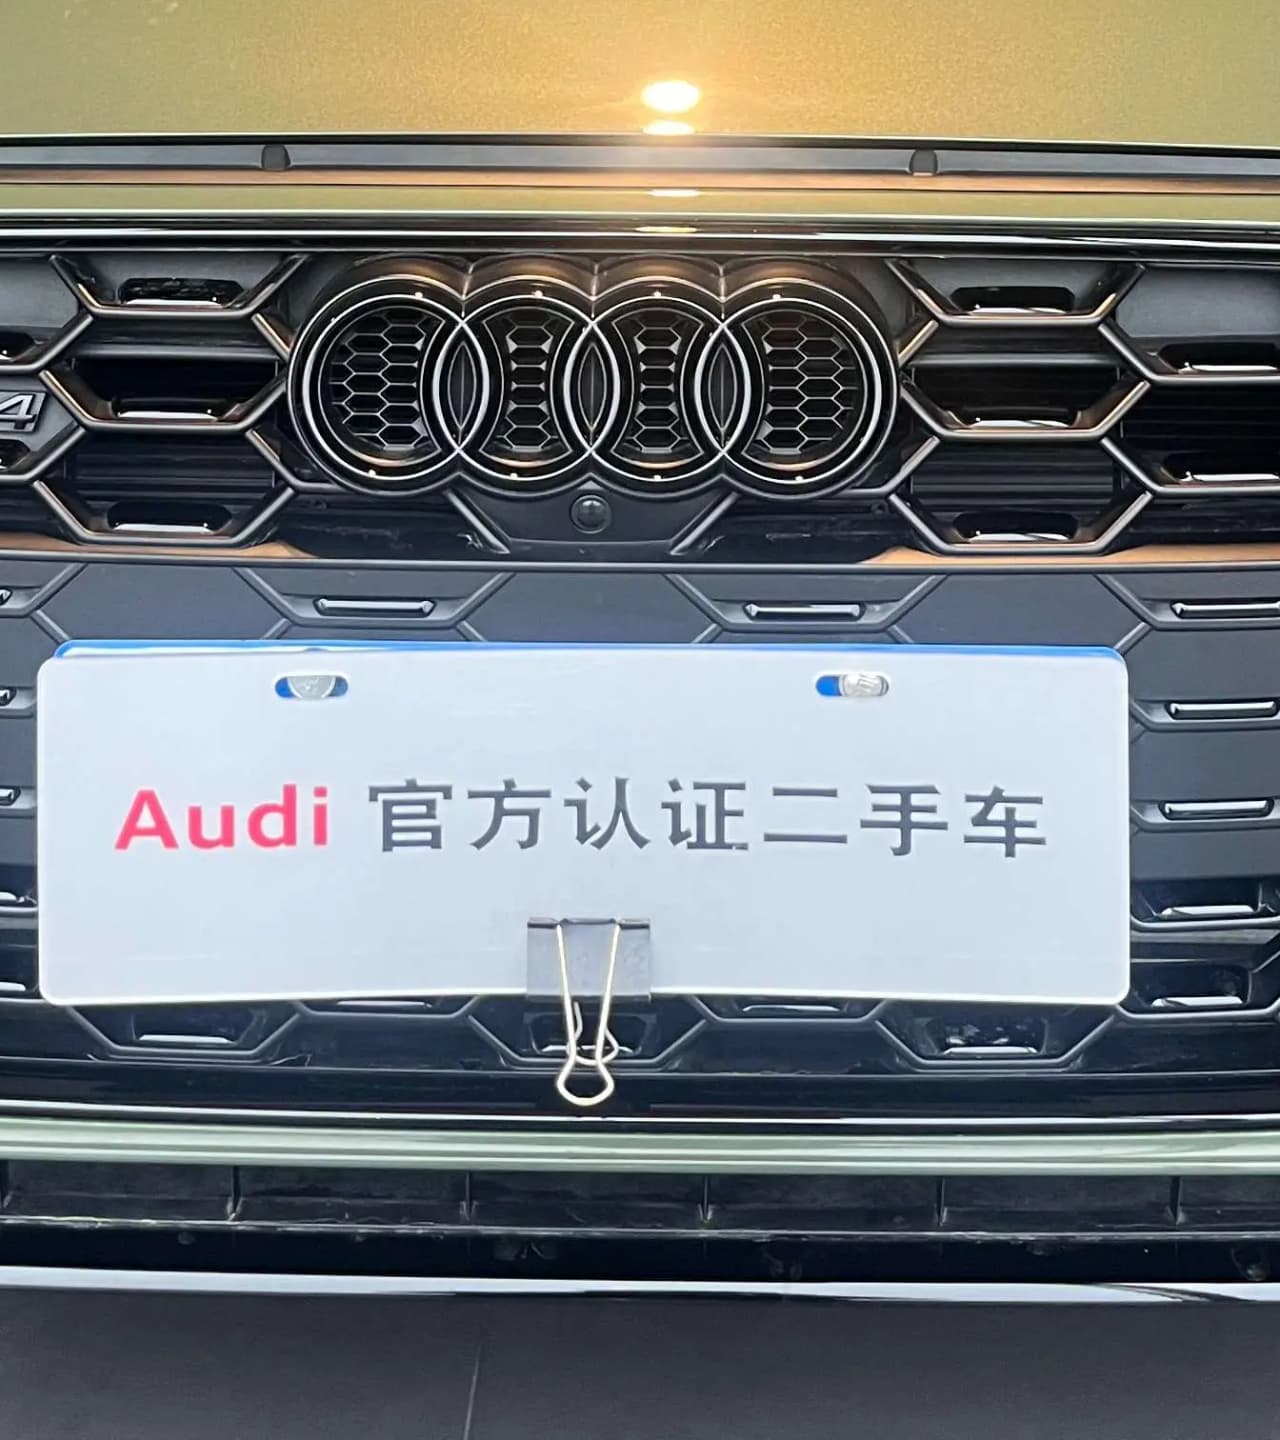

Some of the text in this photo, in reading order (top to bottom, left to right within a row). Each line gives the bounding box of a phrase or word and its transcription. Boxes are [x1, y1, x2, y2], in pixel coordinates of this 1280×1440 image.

[114, 777, 1048, 857] Audi 官方认证二手车
